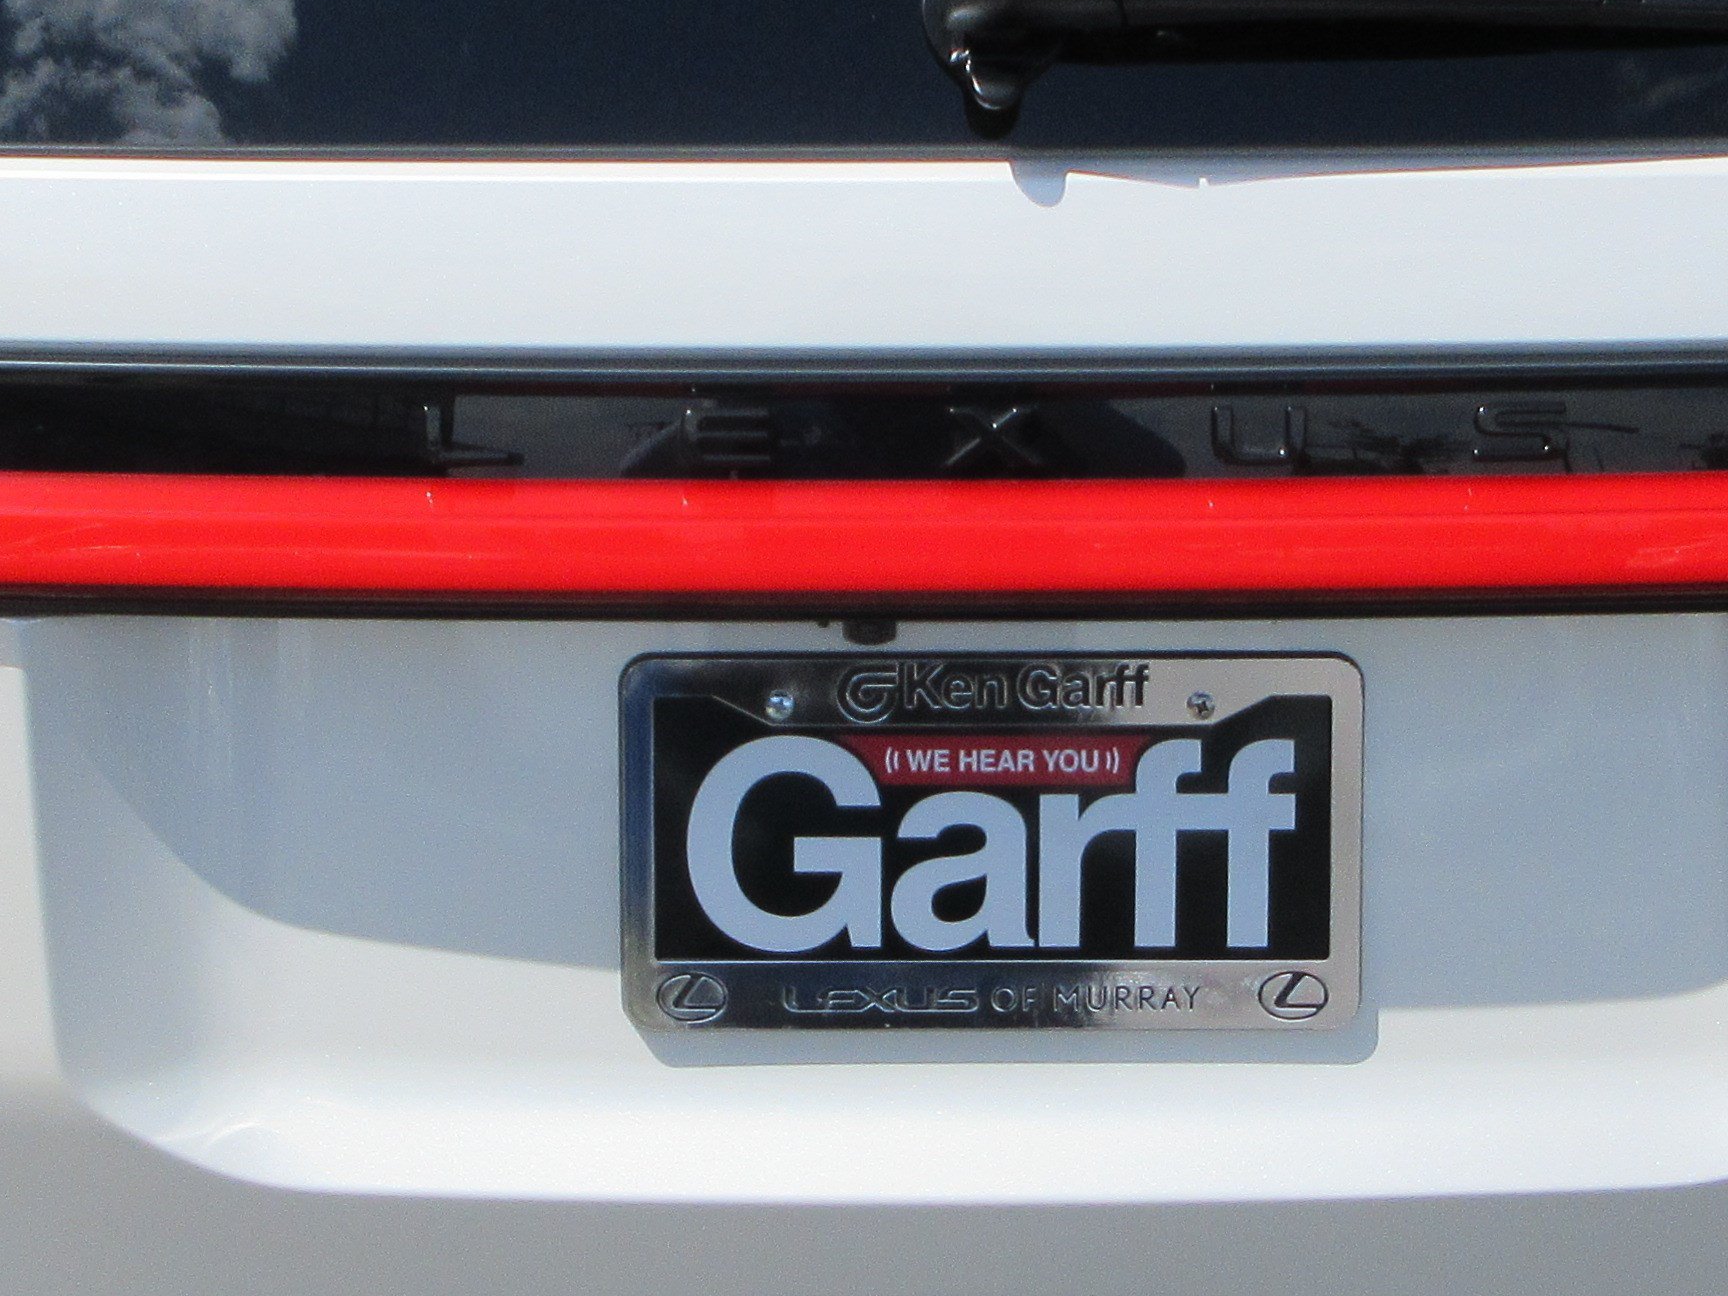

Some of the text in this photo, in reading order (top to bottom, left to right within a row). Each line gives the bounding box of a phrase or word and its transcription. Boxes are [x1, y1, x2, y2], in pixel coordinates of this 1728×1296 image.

[423, 400, 1568, 470] LEXUS
[904, 662, 1150, 710] Ken Garff
[906, 749, 1100, 772] WE HEAR YOU
[686, 735, 1297, 953] Garff
[783, 986, 1201, 1013] LEXUS OF MURRAY
